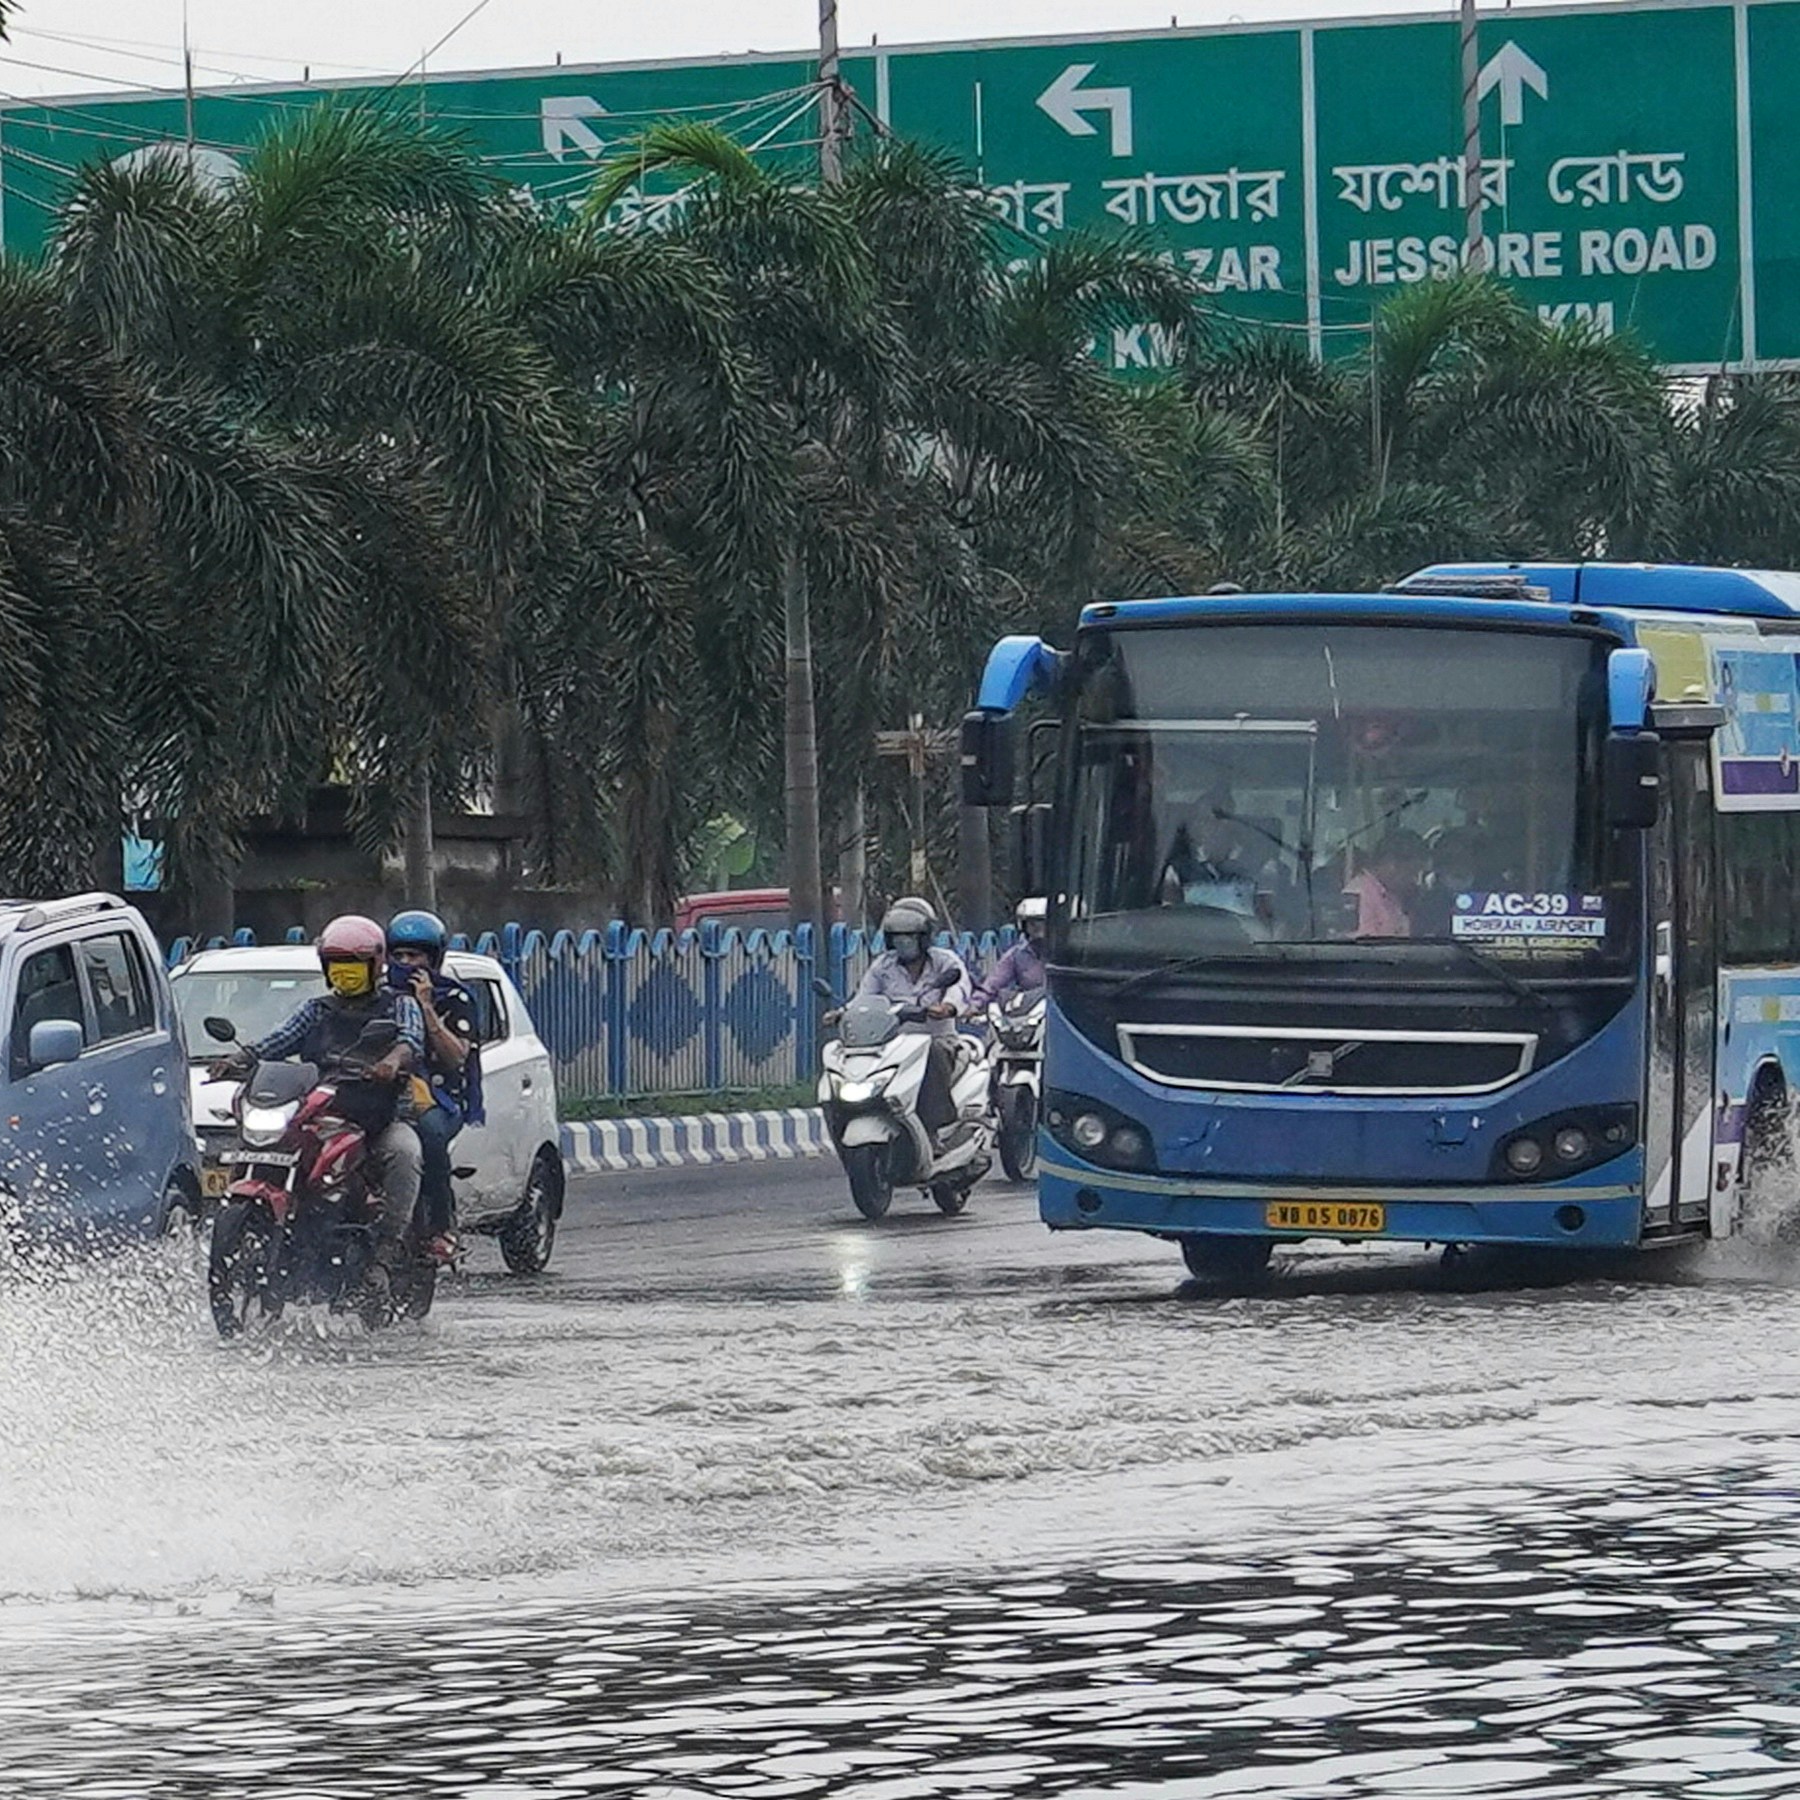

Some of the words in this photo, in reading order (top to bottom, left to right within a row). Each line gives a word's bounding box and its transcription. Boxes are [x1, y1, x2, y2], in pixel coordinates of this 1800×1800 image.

[1102, 166, 1286, 226] বাজার
[1332, 155, 1515, 213] যশোর
[1547, 149, 1686, 208] রোড
[1334, 231, 1563, 286] JESSORE
[1580, 224, 1718, 276] ROAD
[1483, 892, 1570, 915] AC-39
